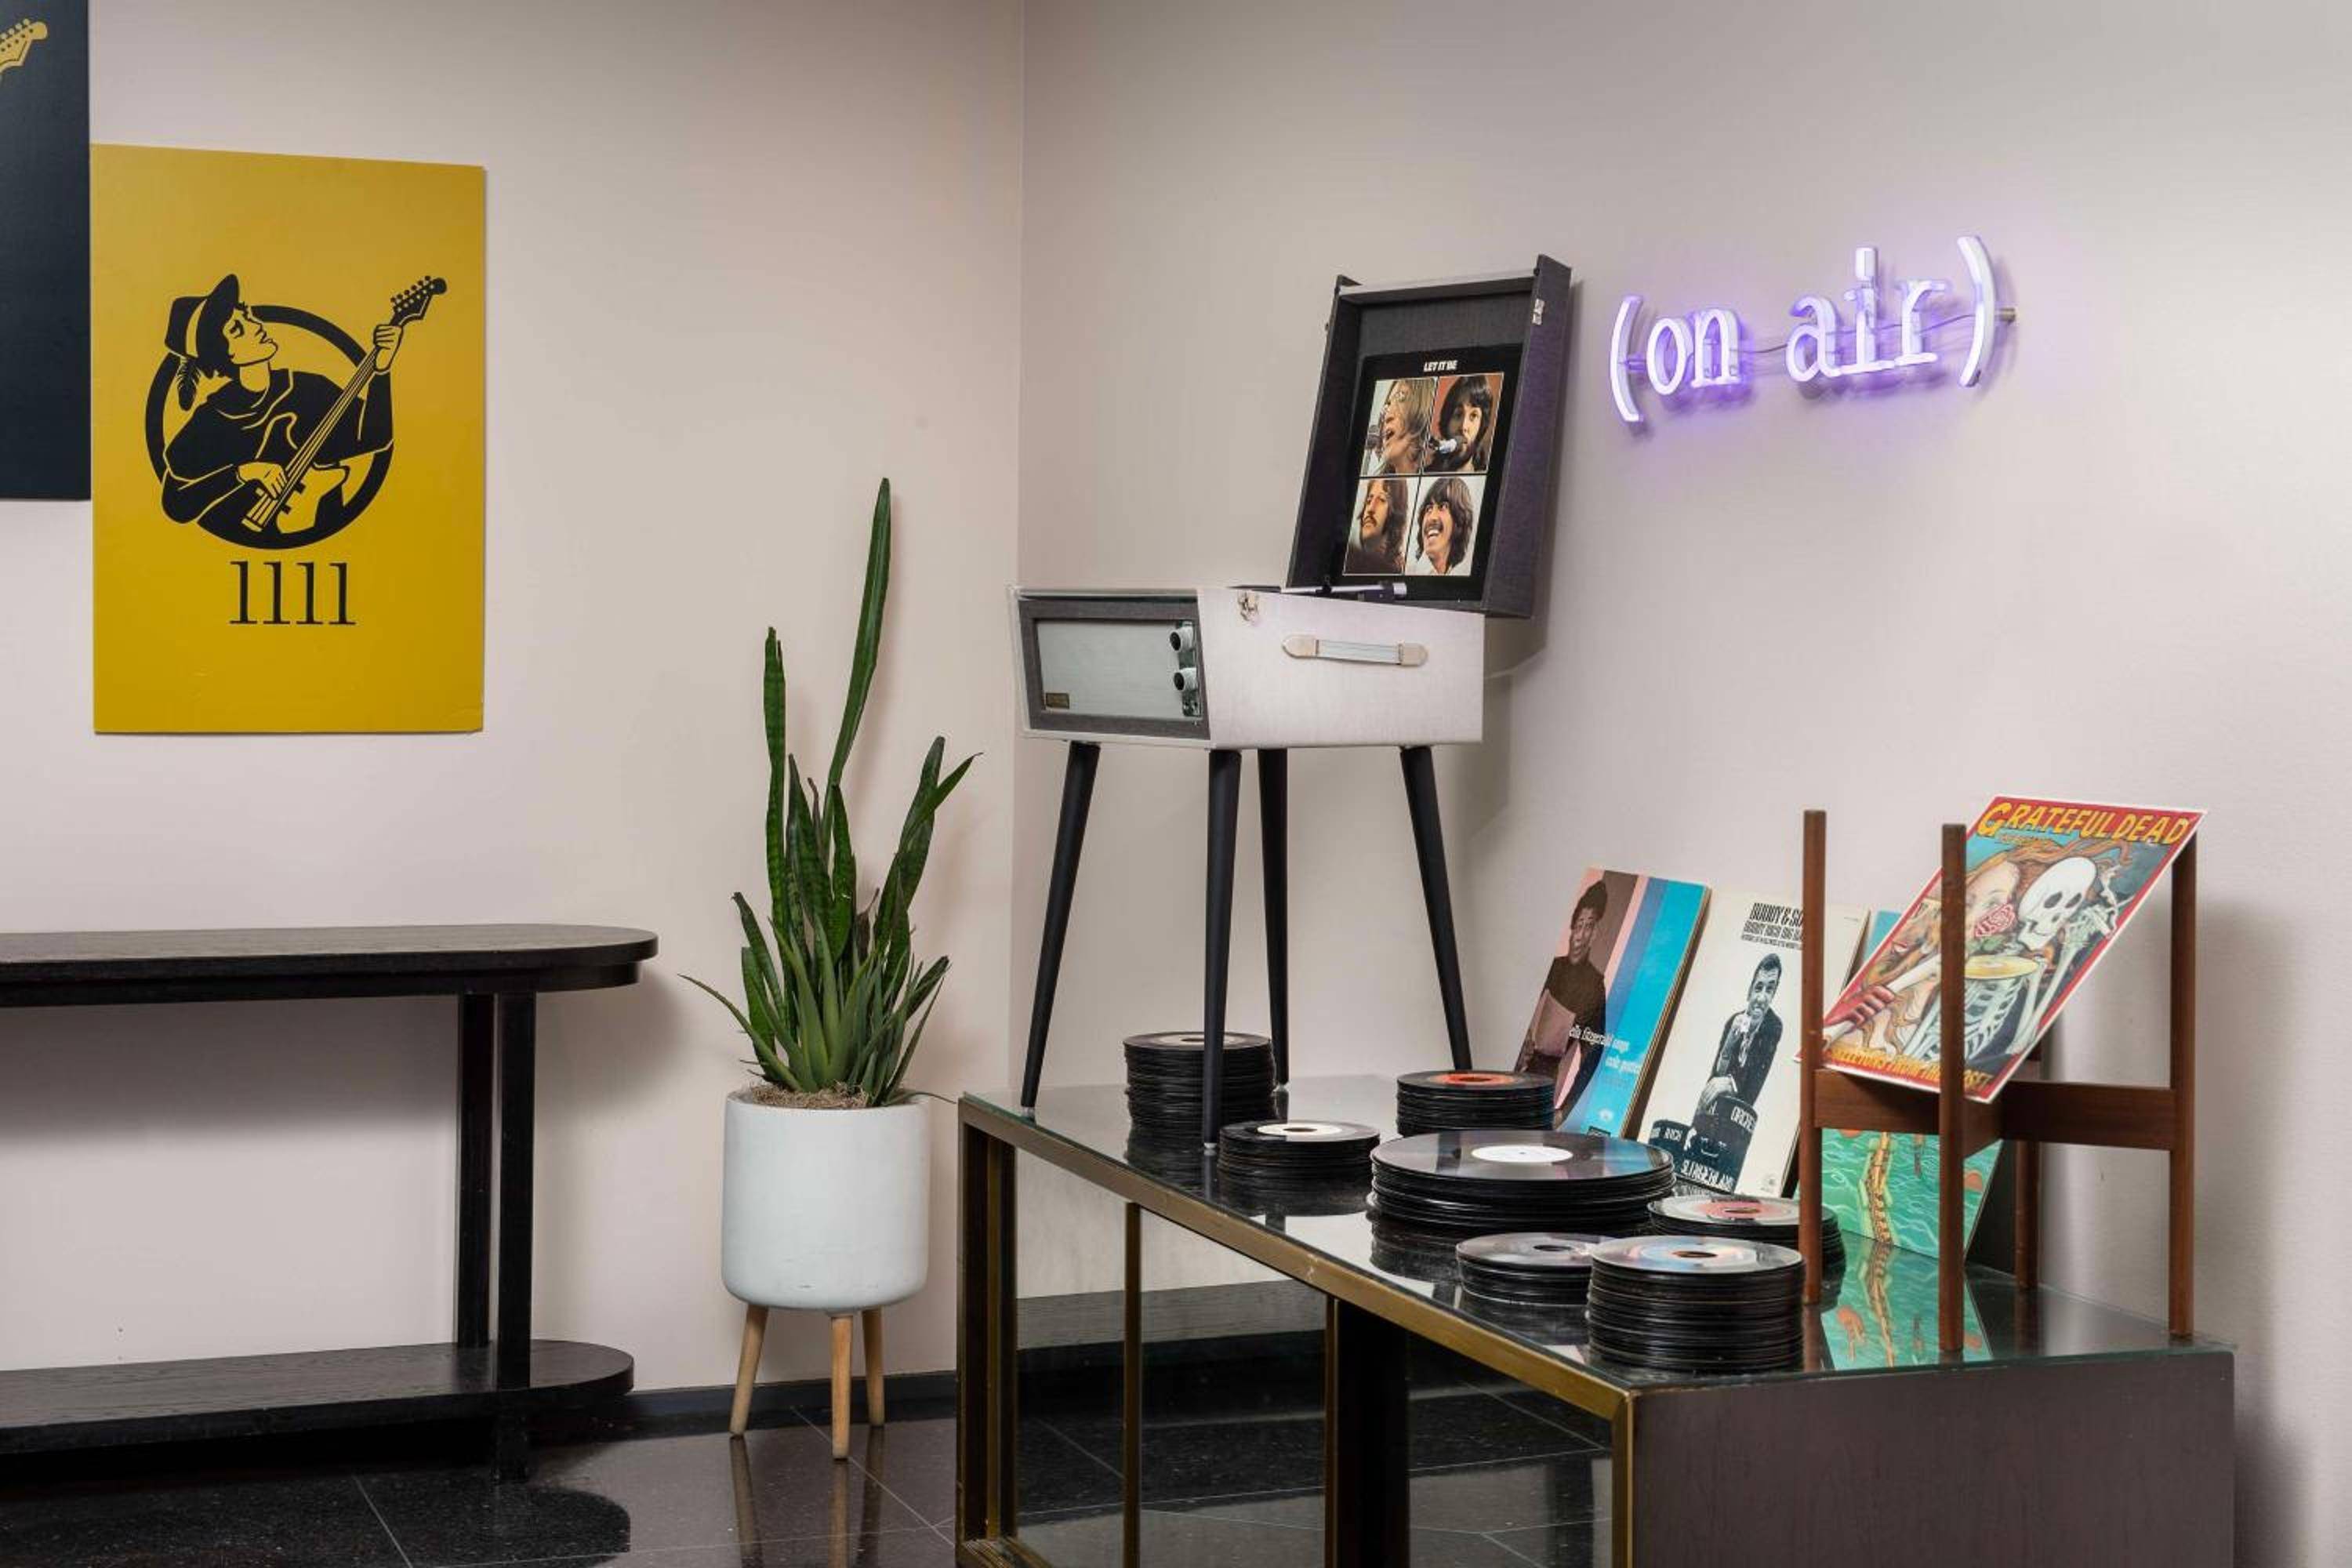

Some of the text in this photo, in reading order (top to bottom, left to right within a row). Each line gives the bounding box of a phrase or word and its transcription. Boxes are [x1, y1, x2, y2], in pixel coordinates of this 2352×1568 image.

[1423, 361, 1439, 372] LET
[229, 560, 356, 625] 1111
[1976, 802, 2190, 844] GRATEFUL DEAD
